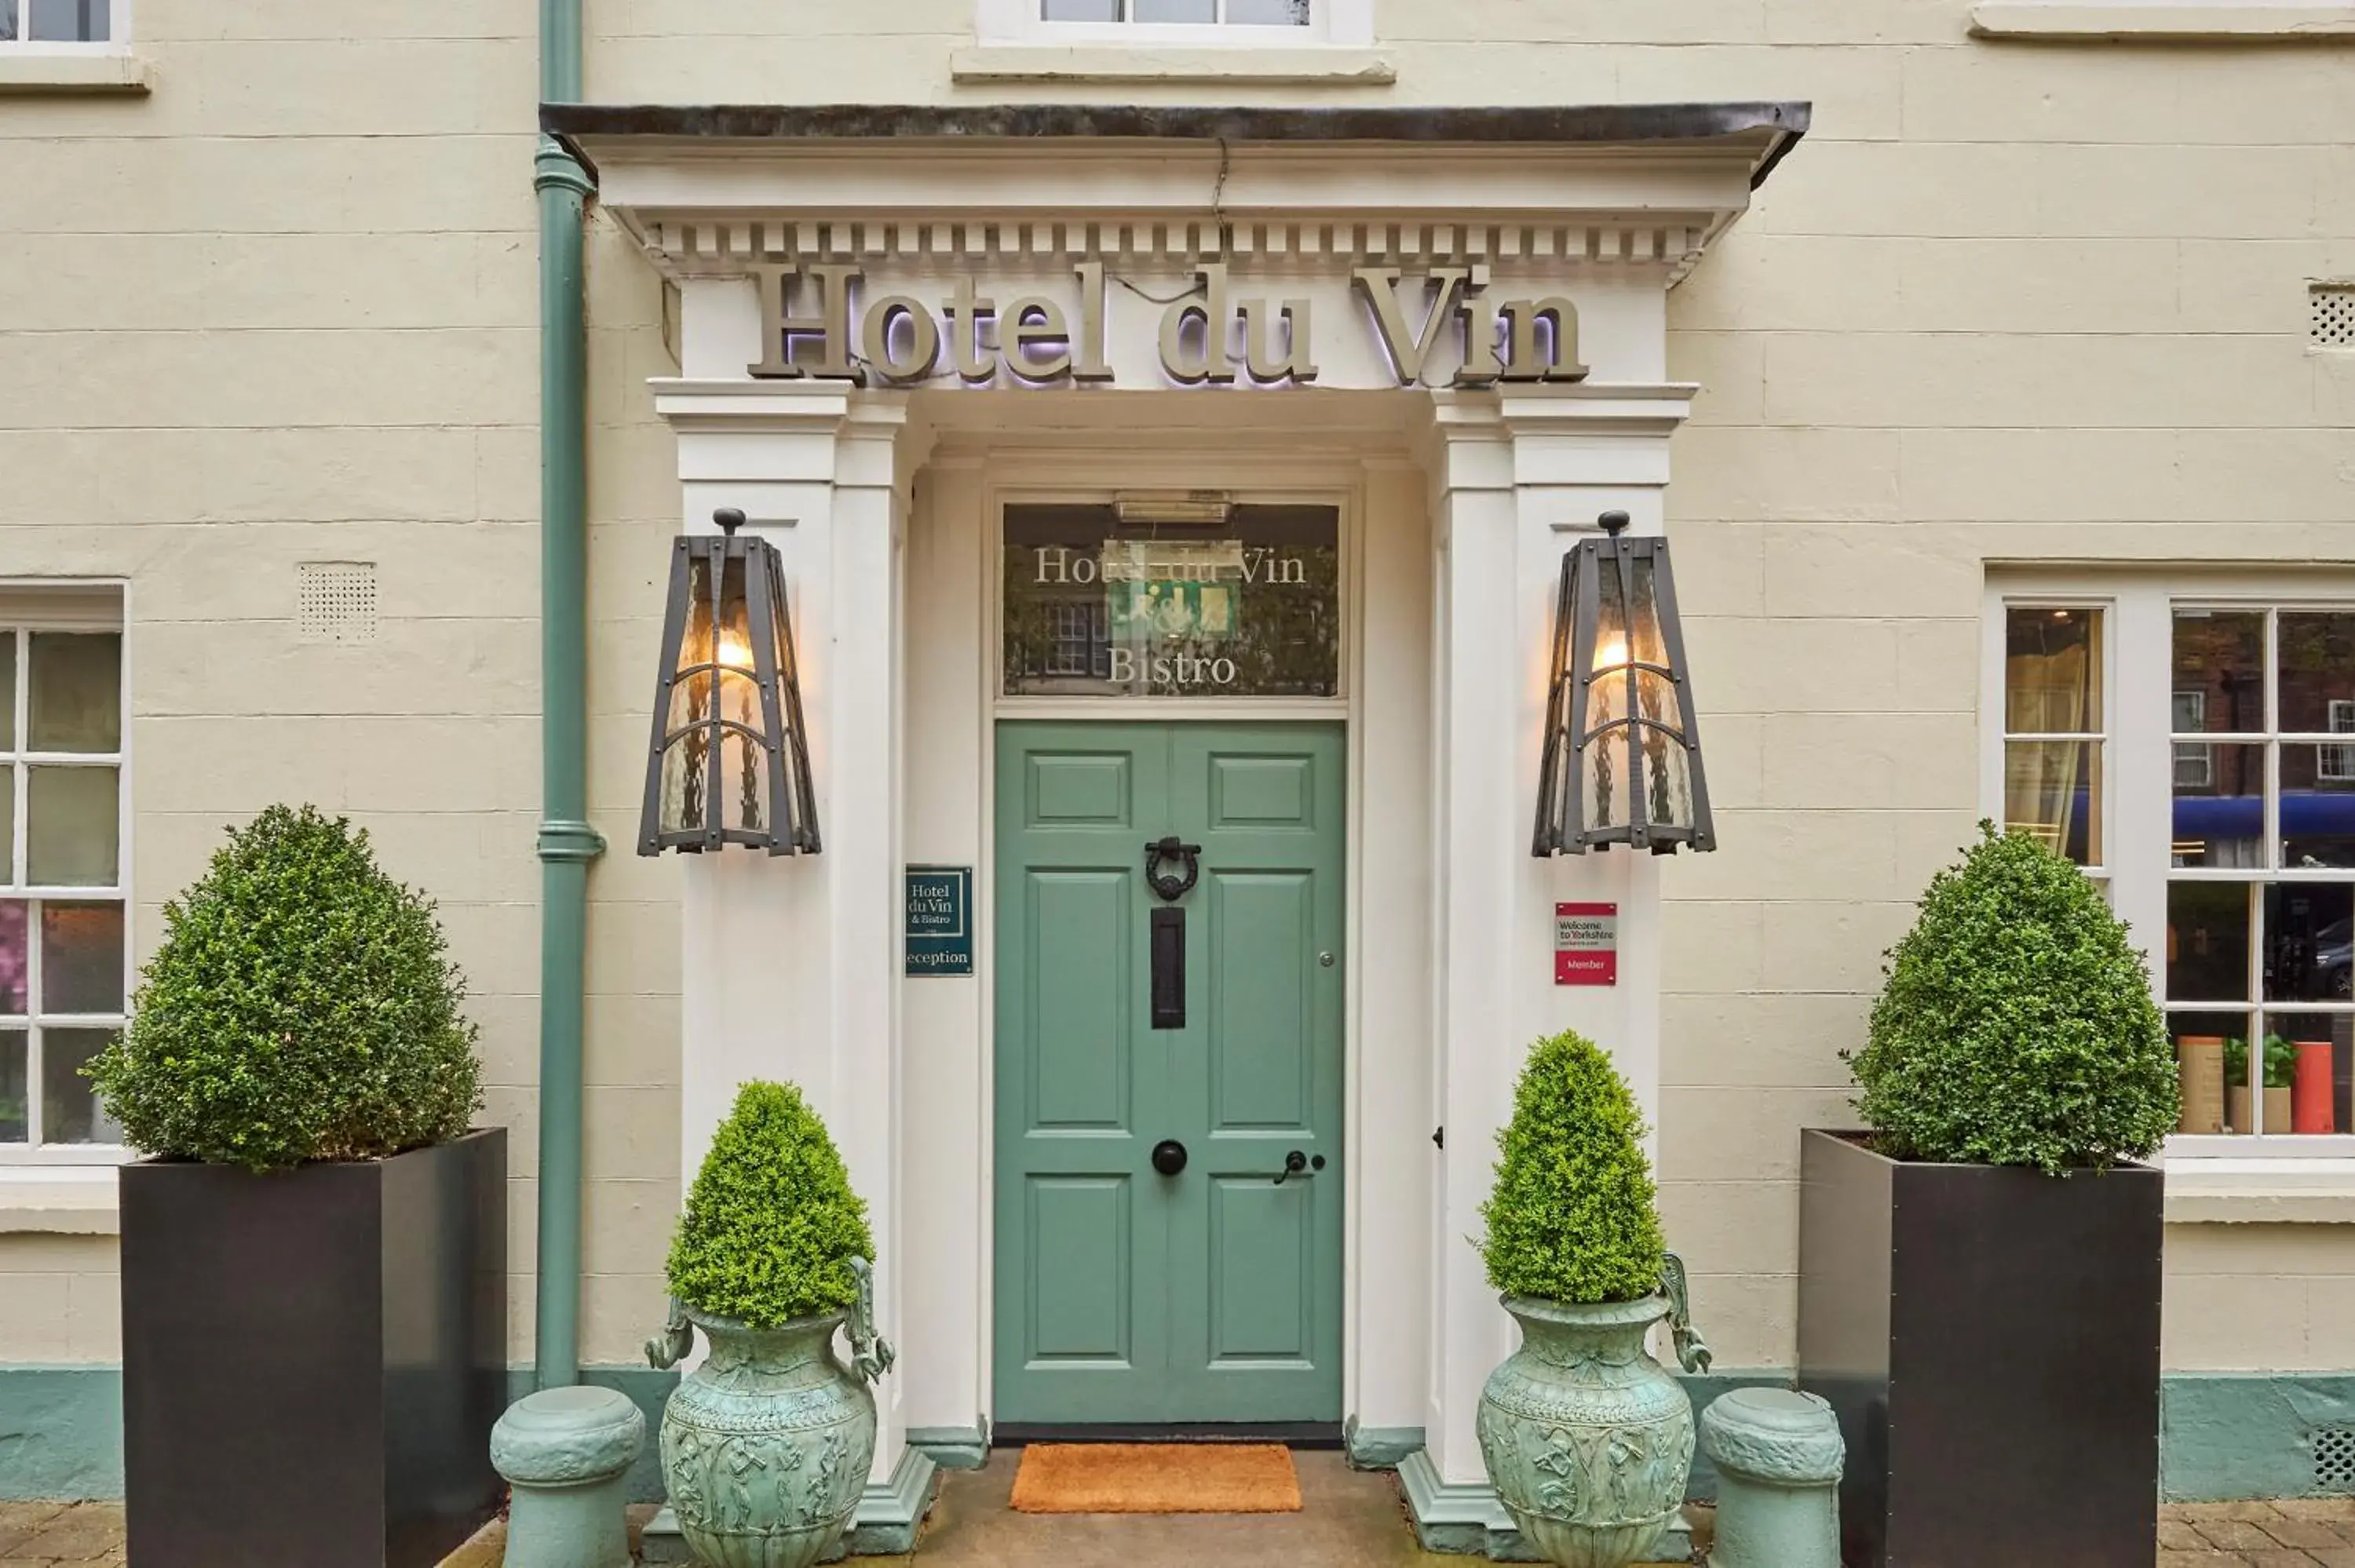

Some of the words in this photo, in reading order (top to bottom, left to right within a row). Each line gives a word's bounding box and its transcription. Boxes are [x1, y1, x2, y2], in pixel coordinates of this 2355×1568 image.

[747, 261, 1115, 383] Hotel
[1159, 264, 1319, 384] du
[1349, 264, 1590, 386] Vin
[1232, 547, 1307, 584] Vin
[1106, 647, 1236, 684] Bistro
[912, 884, 949, 897] Hotel
[908, 899, 926, 913] du
[928, 899, 951, 913] Vin
[911, 914, 920, 924] &
[921, 915, 951, 924] Bistro
[1560, 921, 1601, 930] Welcome
[1560, 931, 1571, 939] to
[1572, 931, 1614, 939] Yorkshire
[907, 950, 967, 965] eception
[1568, 960, 1605, 969] Member
